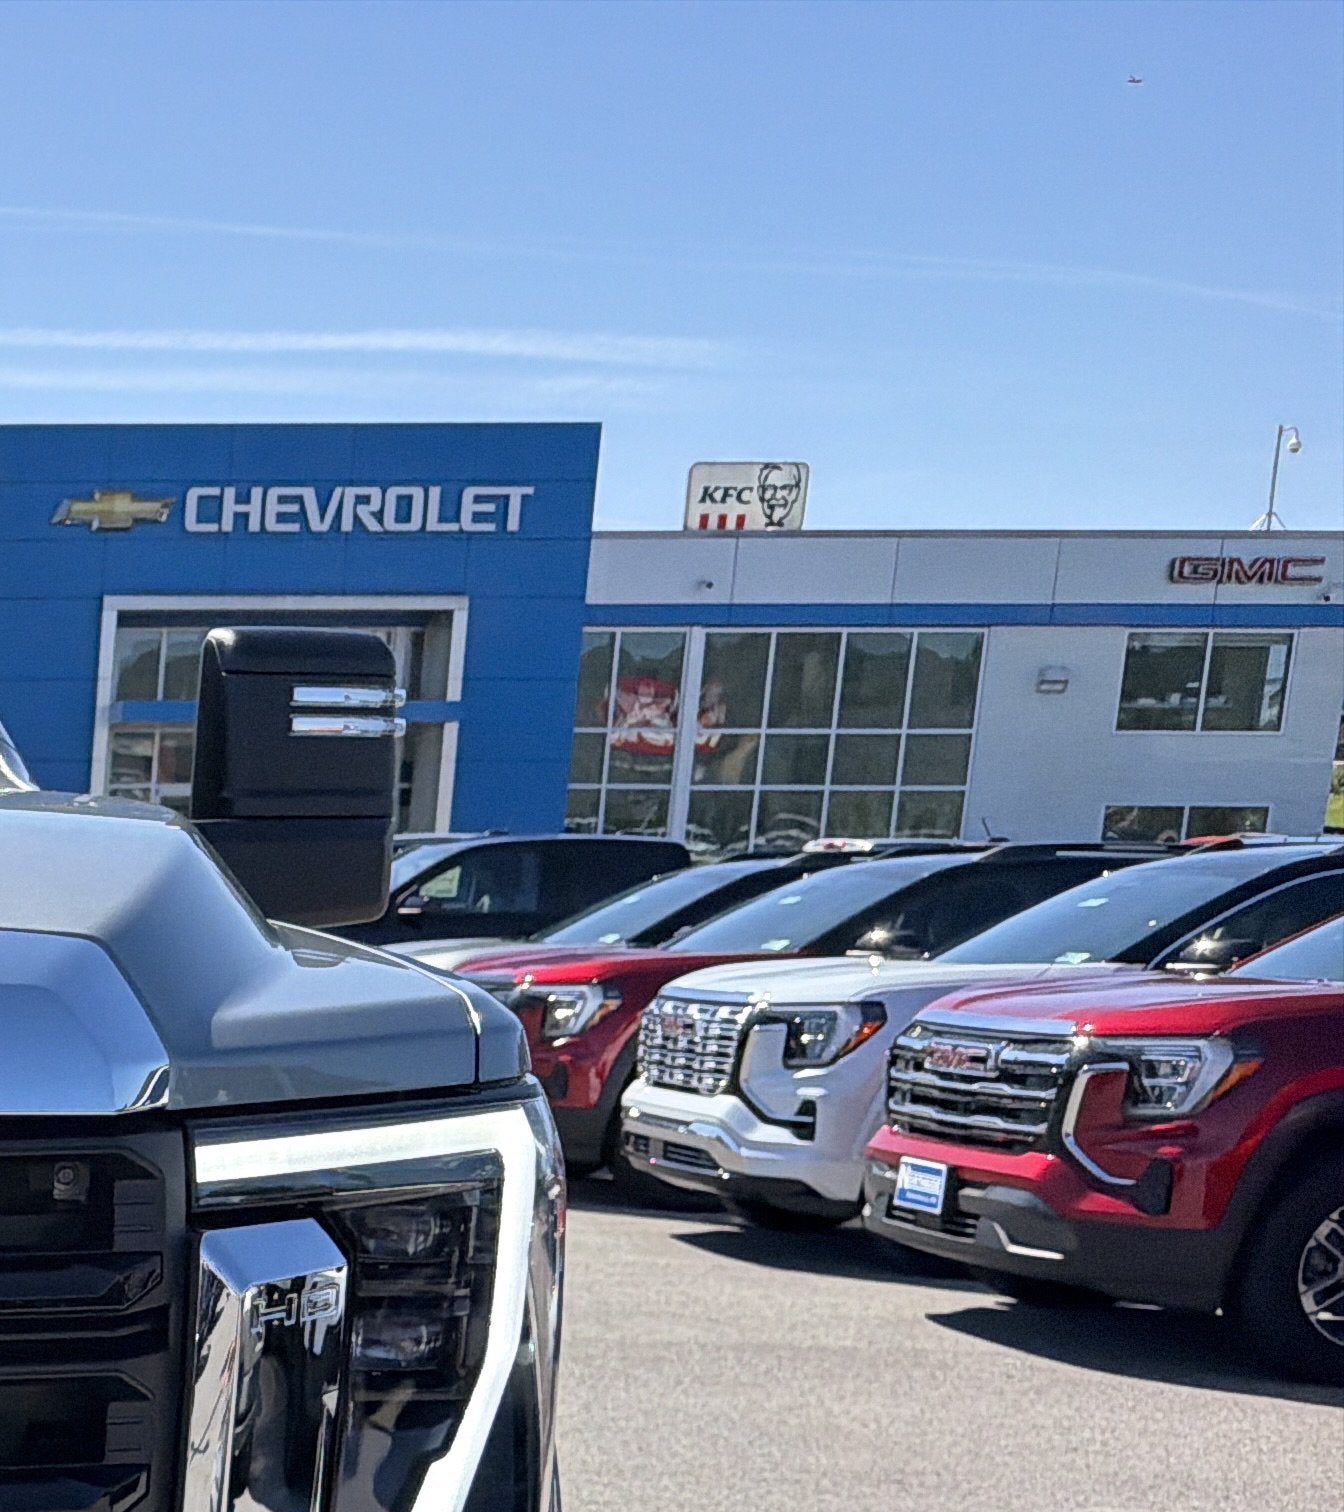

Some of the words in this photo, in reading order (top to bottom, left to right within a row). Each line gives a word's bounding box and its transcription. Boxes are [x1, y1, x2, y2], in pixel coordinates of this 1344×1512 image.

[184, 486, 534, 533] CHEVROLET
[698, 485, 754, 505] KFC
[1169, 556, 1326, 586] GMC
